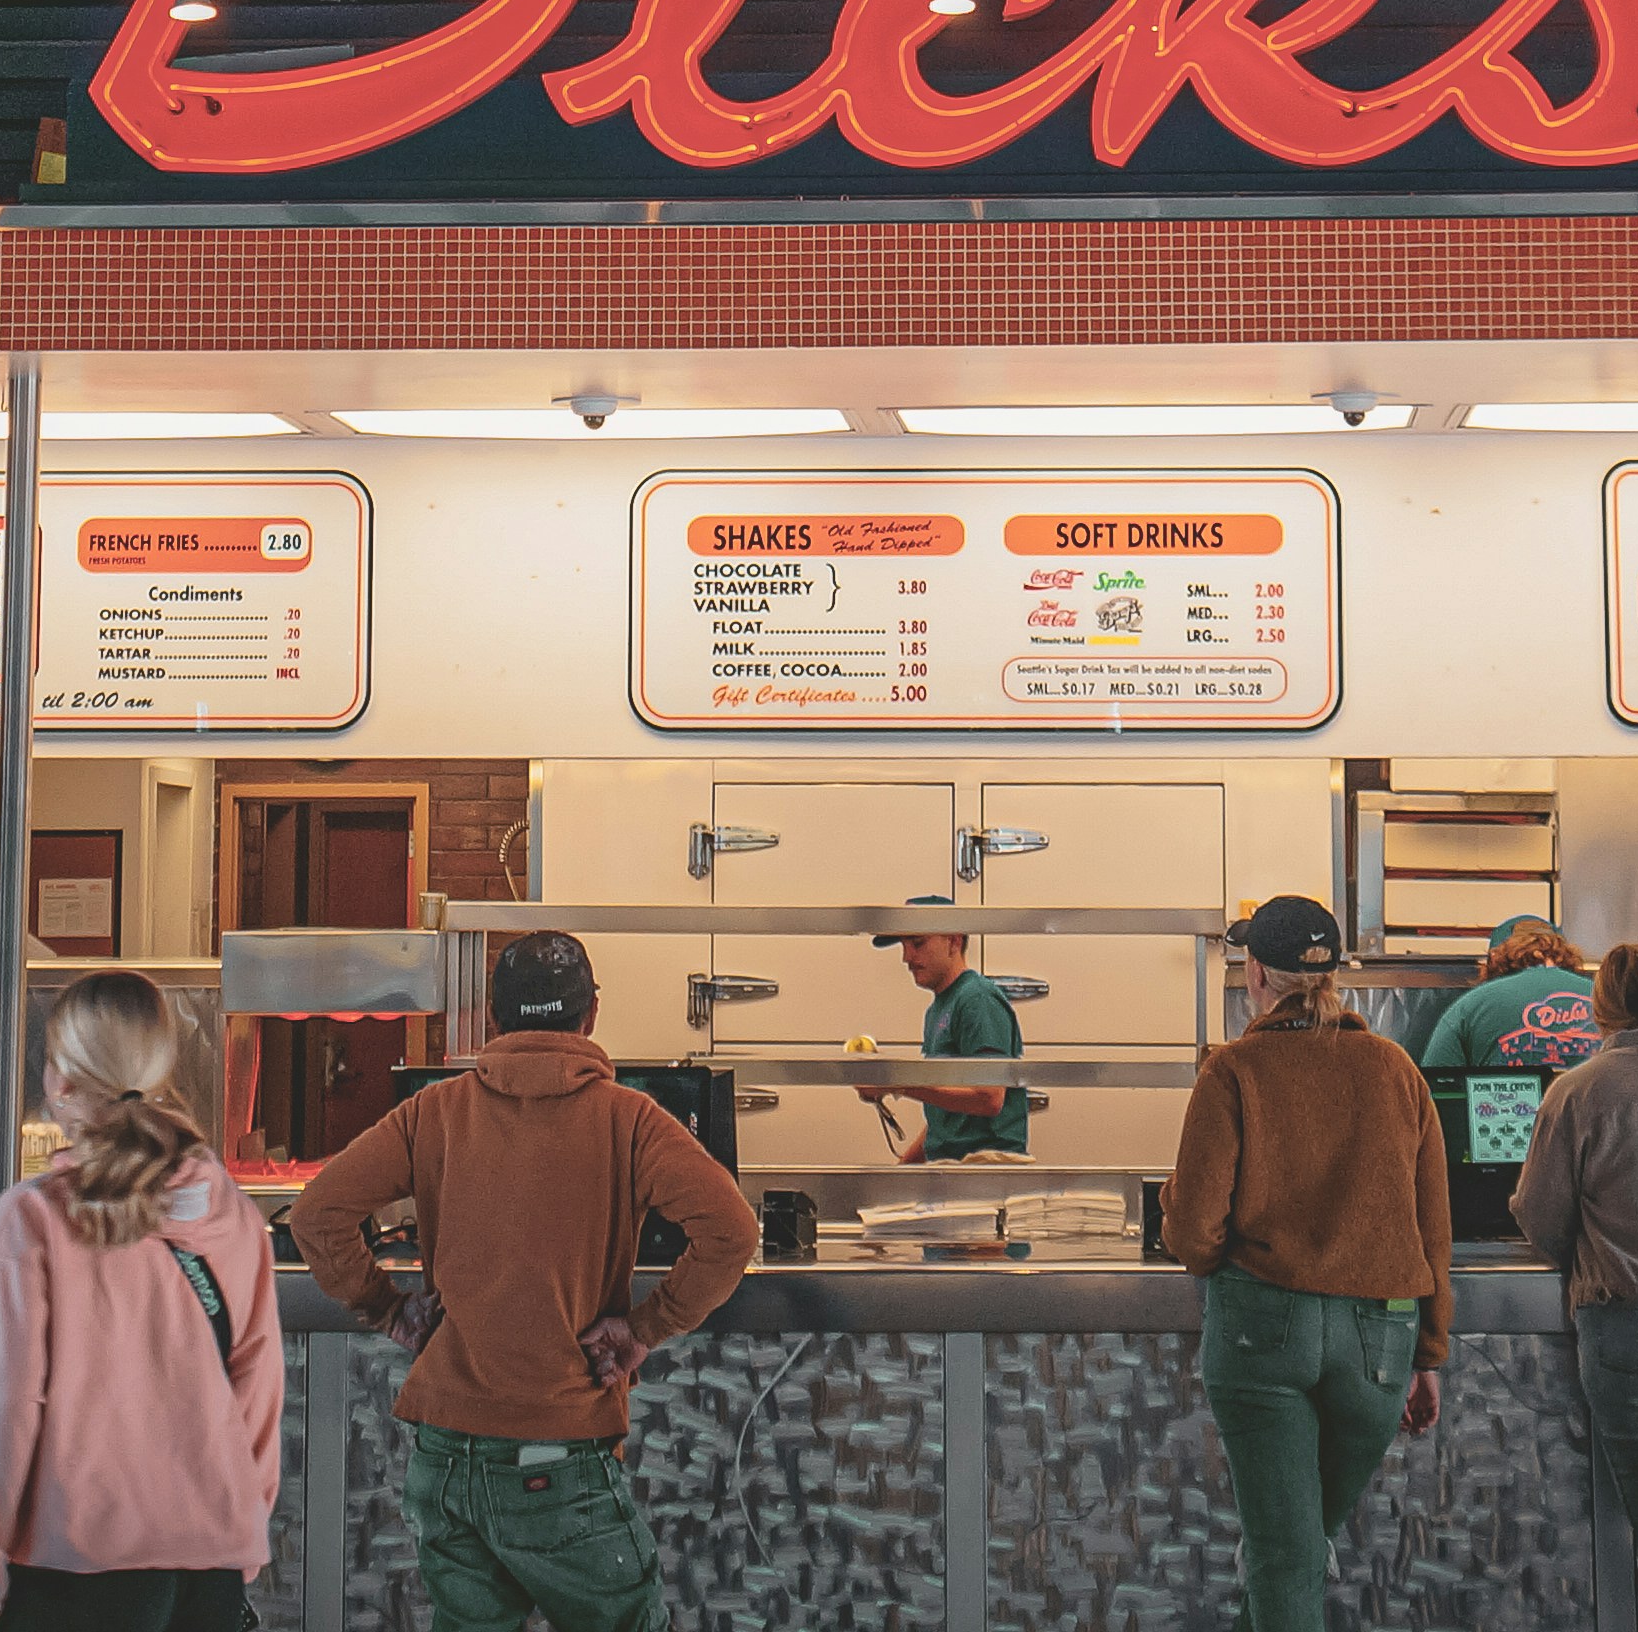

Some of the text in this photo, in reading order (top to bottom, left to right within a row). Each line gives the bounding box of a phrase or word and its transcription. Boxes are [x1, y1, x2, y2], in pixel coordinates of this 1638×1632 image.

[861, 520, 931, 536] Fashioned
[90, 534, 301, 551] FRENCH FRIES 2.80
[714, 525, 811, 550] SHAKES
[1057, 523, 1223, 548] SOFT DRINKS
[833, 540, 874, 552] Hand
[694, 564, 801, 577] CHOCOLATE
[695, 580, 926, 595] STRAWBERRY 3.80
[1093, 569, 1147, 592] Sprite
[149, 585, 242, 601] Condiments
[1256, 584, 1283, 597] 2.00
[693, 598, 770, 612] VANILLA
[1256, 605, 1284, 619] 2.30
[100, 608, 300, 620] ONIONS .20
[100, 628, 300, 640] KETCHUP .20
[713, 620, 927, 634] FLOAT 3.80
[1063, 637, 1084, 645] Maid
[1257, 628, 1285, 642] 2.50
[99, 648, 299, 659] TARTAR .20
[713, 642, 926, 655] MILK 1.85
[98, 667, 300, 679] MUSTARD INCL
[713, 663, 927, 679] COFFEE, COCOA 2.00
[1017, 664, 1272, 676] Seattle's Sugar Drink Tax will be added to all non-diet sodas
[42, 693, 65, 709] til
[71, 691, 118, 708] 2:00
[125, 698, 153, 708] am
[713, 685, 926, 707] Gift Certificates 5.00
[1536, 1002, 1588, 1027] Dick's
